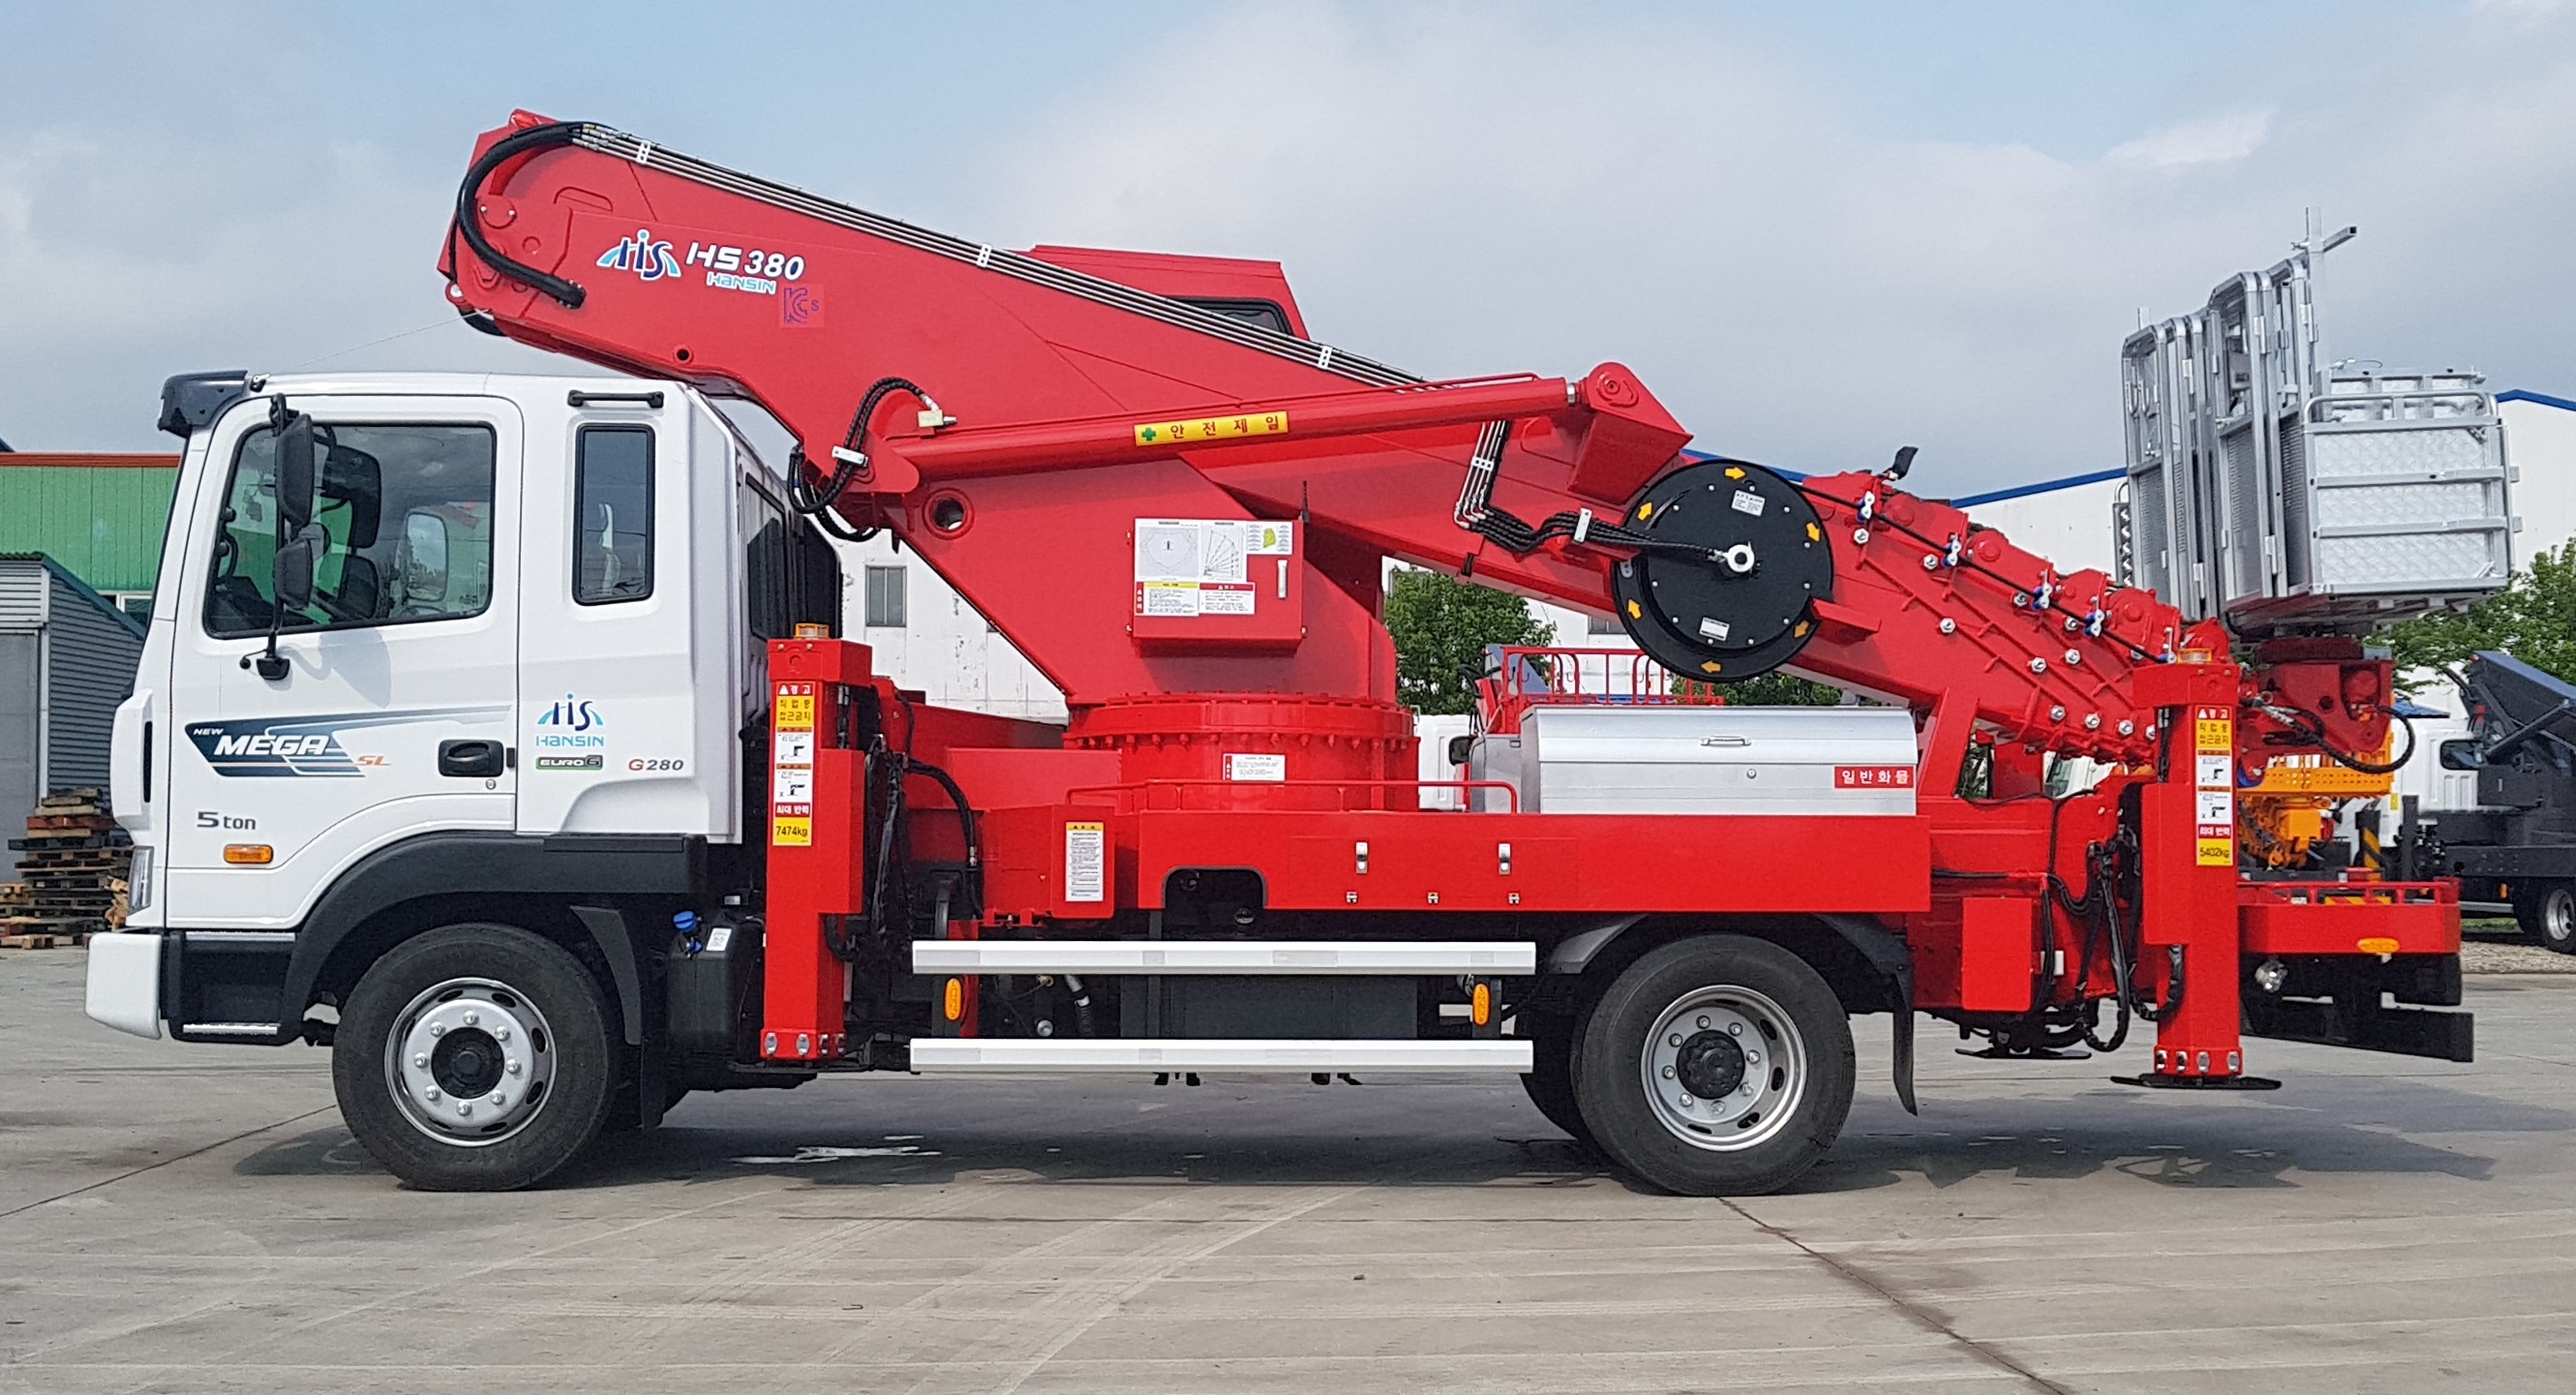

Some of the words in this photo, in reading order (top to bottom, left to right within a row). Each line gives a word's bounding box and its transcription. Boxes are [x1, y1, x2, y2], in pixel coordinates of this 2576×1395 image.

[1170, 415, 1279, 439] 안전제일
[214, 735, 330, 755] MEGA
[357, 755, 388, 766] SL
[628, 759, 683, 771] G280
[1841, 770, 1909, 784] 일반화물
[197, 811, 220, 828] 5
[224, 816, 257, 830] ton
[775, 826, 808, 837] 7474kg
